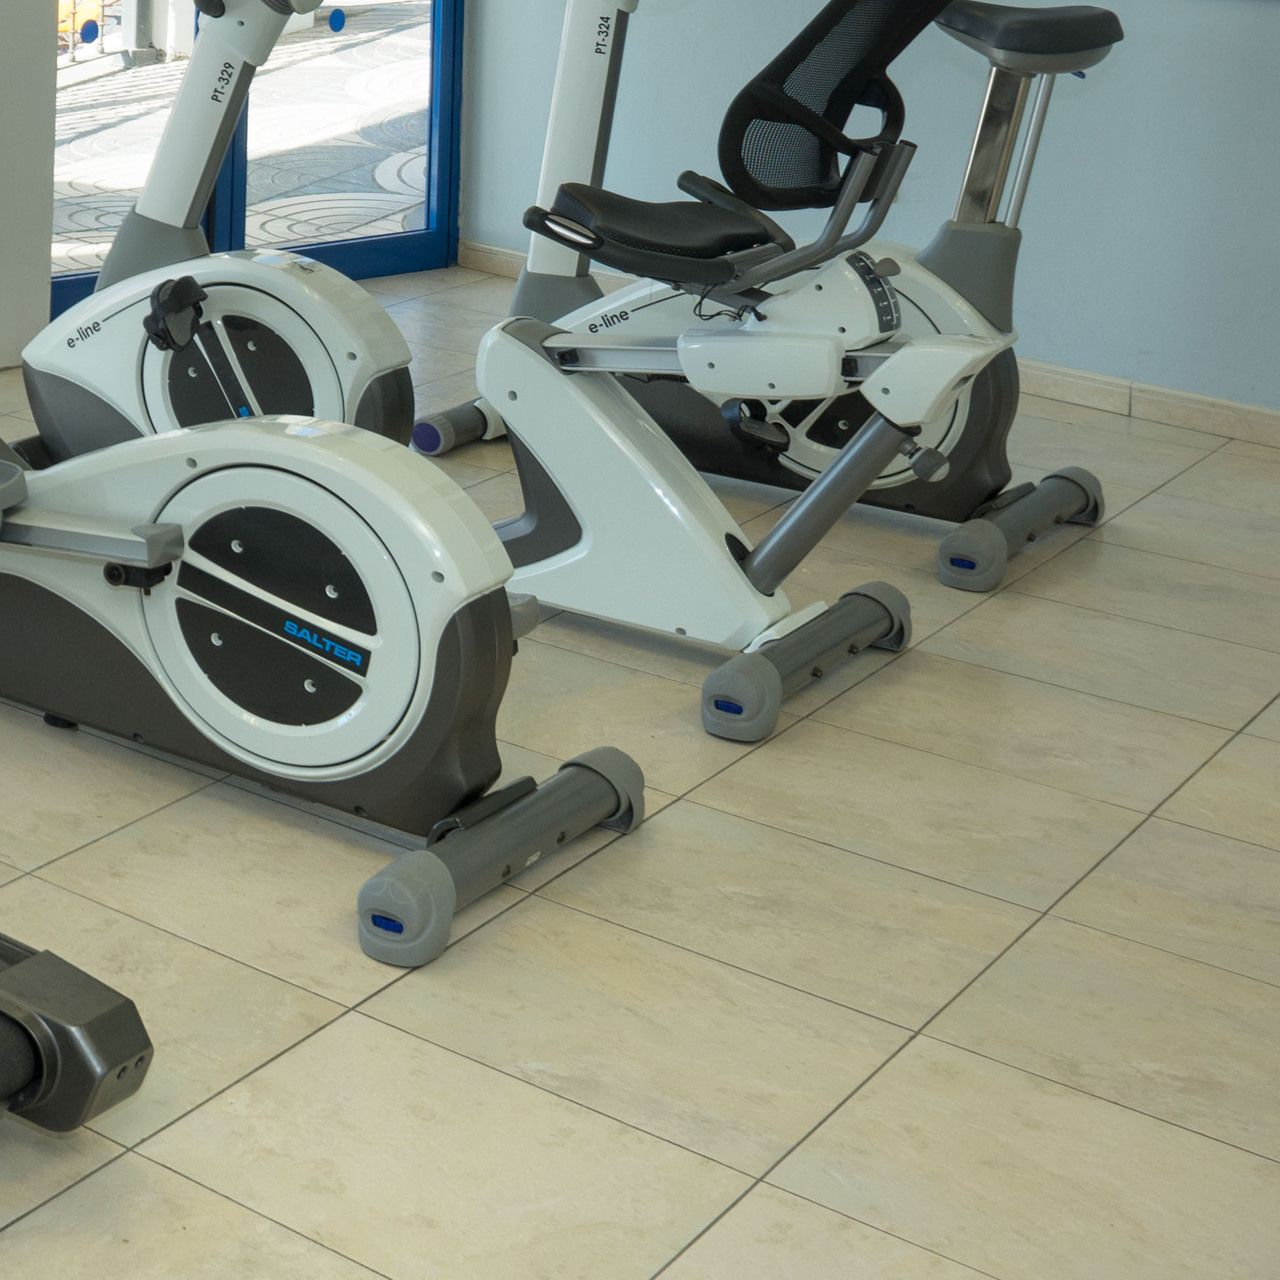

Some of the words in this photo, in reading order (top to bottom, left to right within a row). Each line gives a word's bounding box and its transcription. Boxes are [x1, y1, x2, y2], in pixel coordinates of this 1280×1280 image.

[595, 16, 611, 55] PT-324
[211, 62, 235, 103] PT-329
[67, 321, 101, 348] e-line
[588, 310, 630, 334] e-line
[283, 619, 363, 667] SALTER
